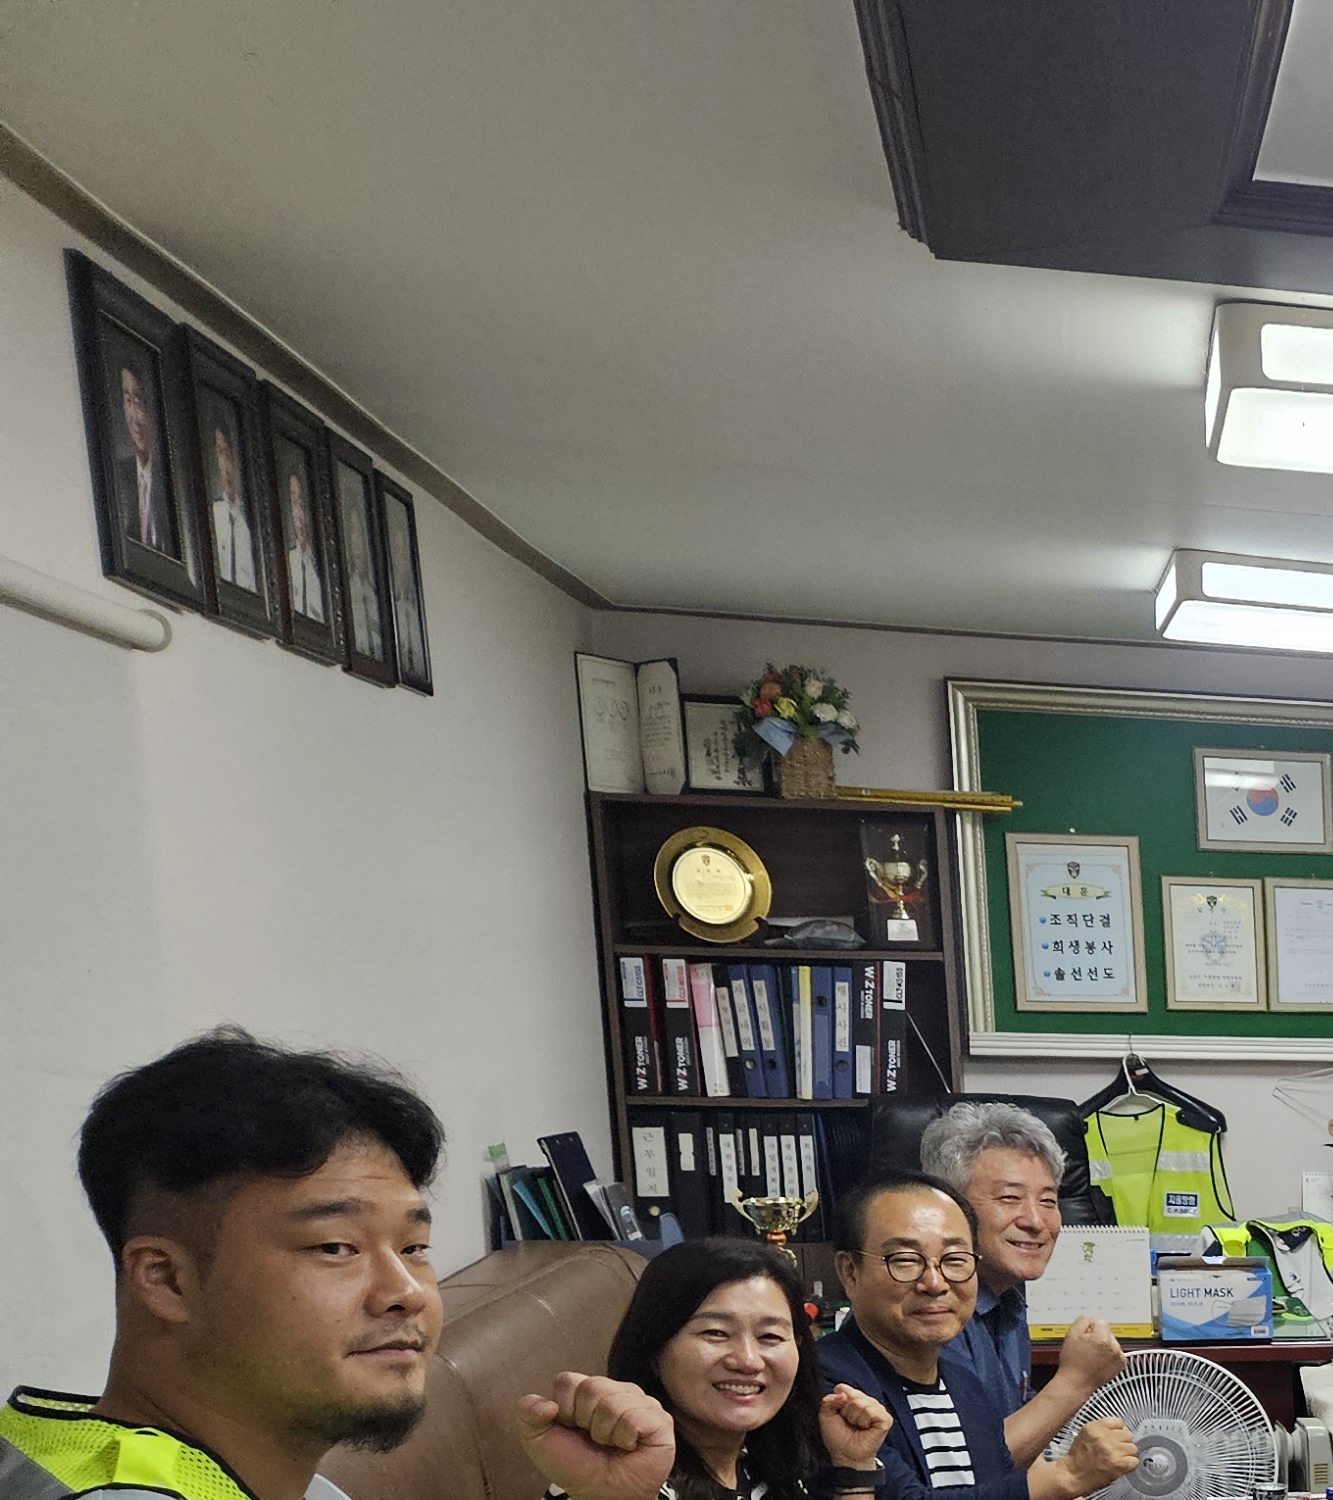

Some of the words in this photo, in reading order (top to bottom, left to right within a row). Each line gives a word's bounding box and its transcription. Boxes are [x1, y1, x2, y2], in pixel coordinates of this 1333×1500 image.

[1050, 913, 1111, 928] 조직단결
[1170, 1288, 1200, 1298] LIGHT
[1204, 1287, 1234, 1298] MASK
